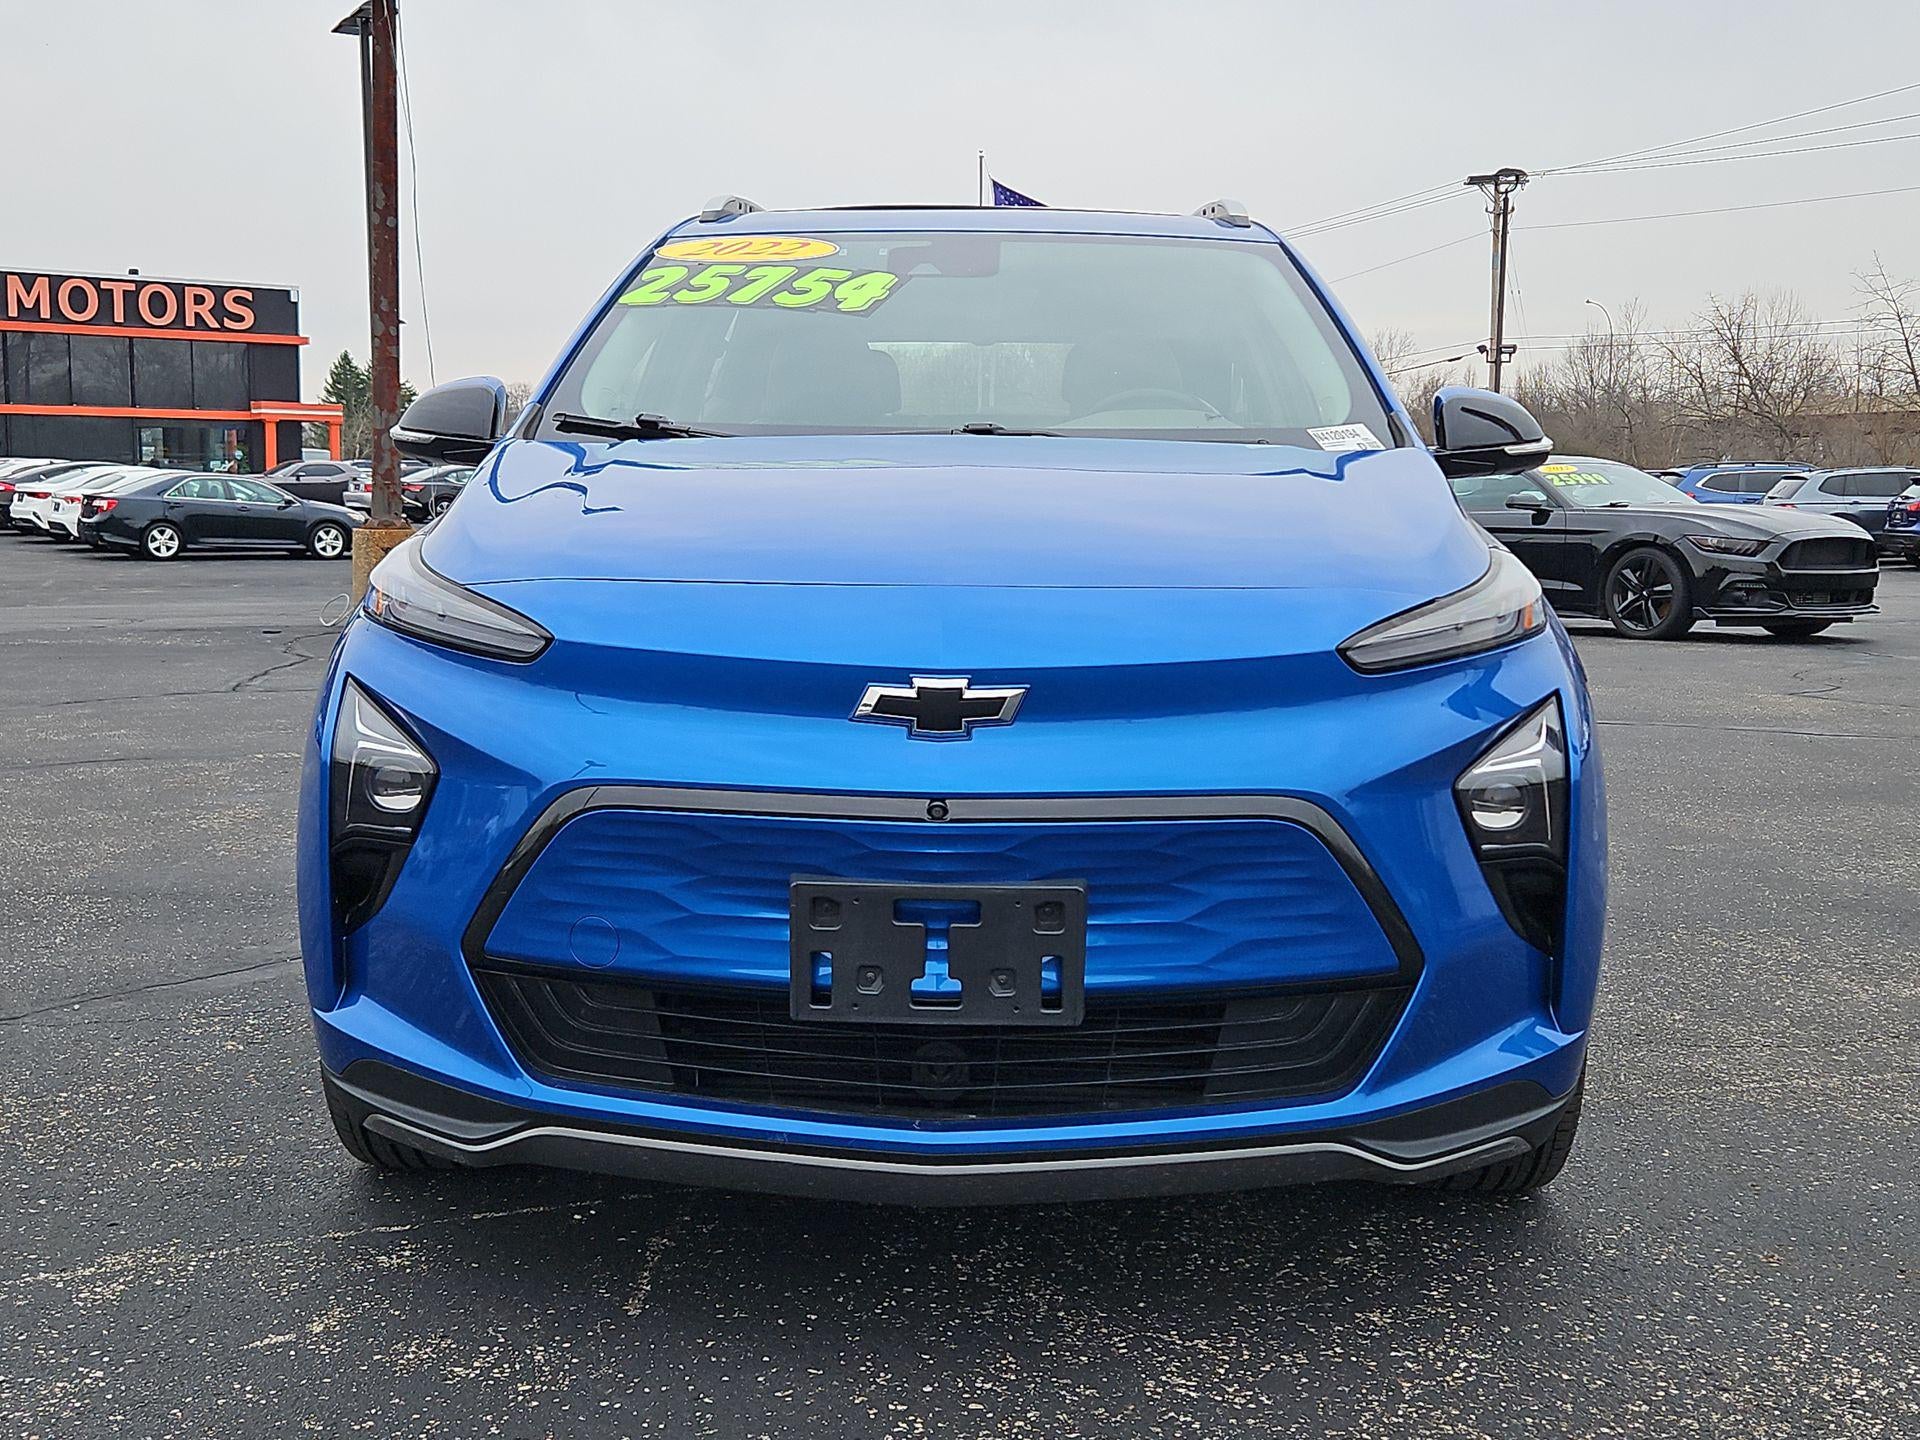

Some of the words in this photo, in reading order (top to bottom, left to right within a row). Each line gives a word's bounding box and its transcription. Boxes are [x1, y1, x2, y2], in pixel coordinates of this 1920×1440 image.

[679, 241, 812, 256] 2022
[6, 275, 256, 330] MOTORS
[618, 264, 899, 311] 25754
